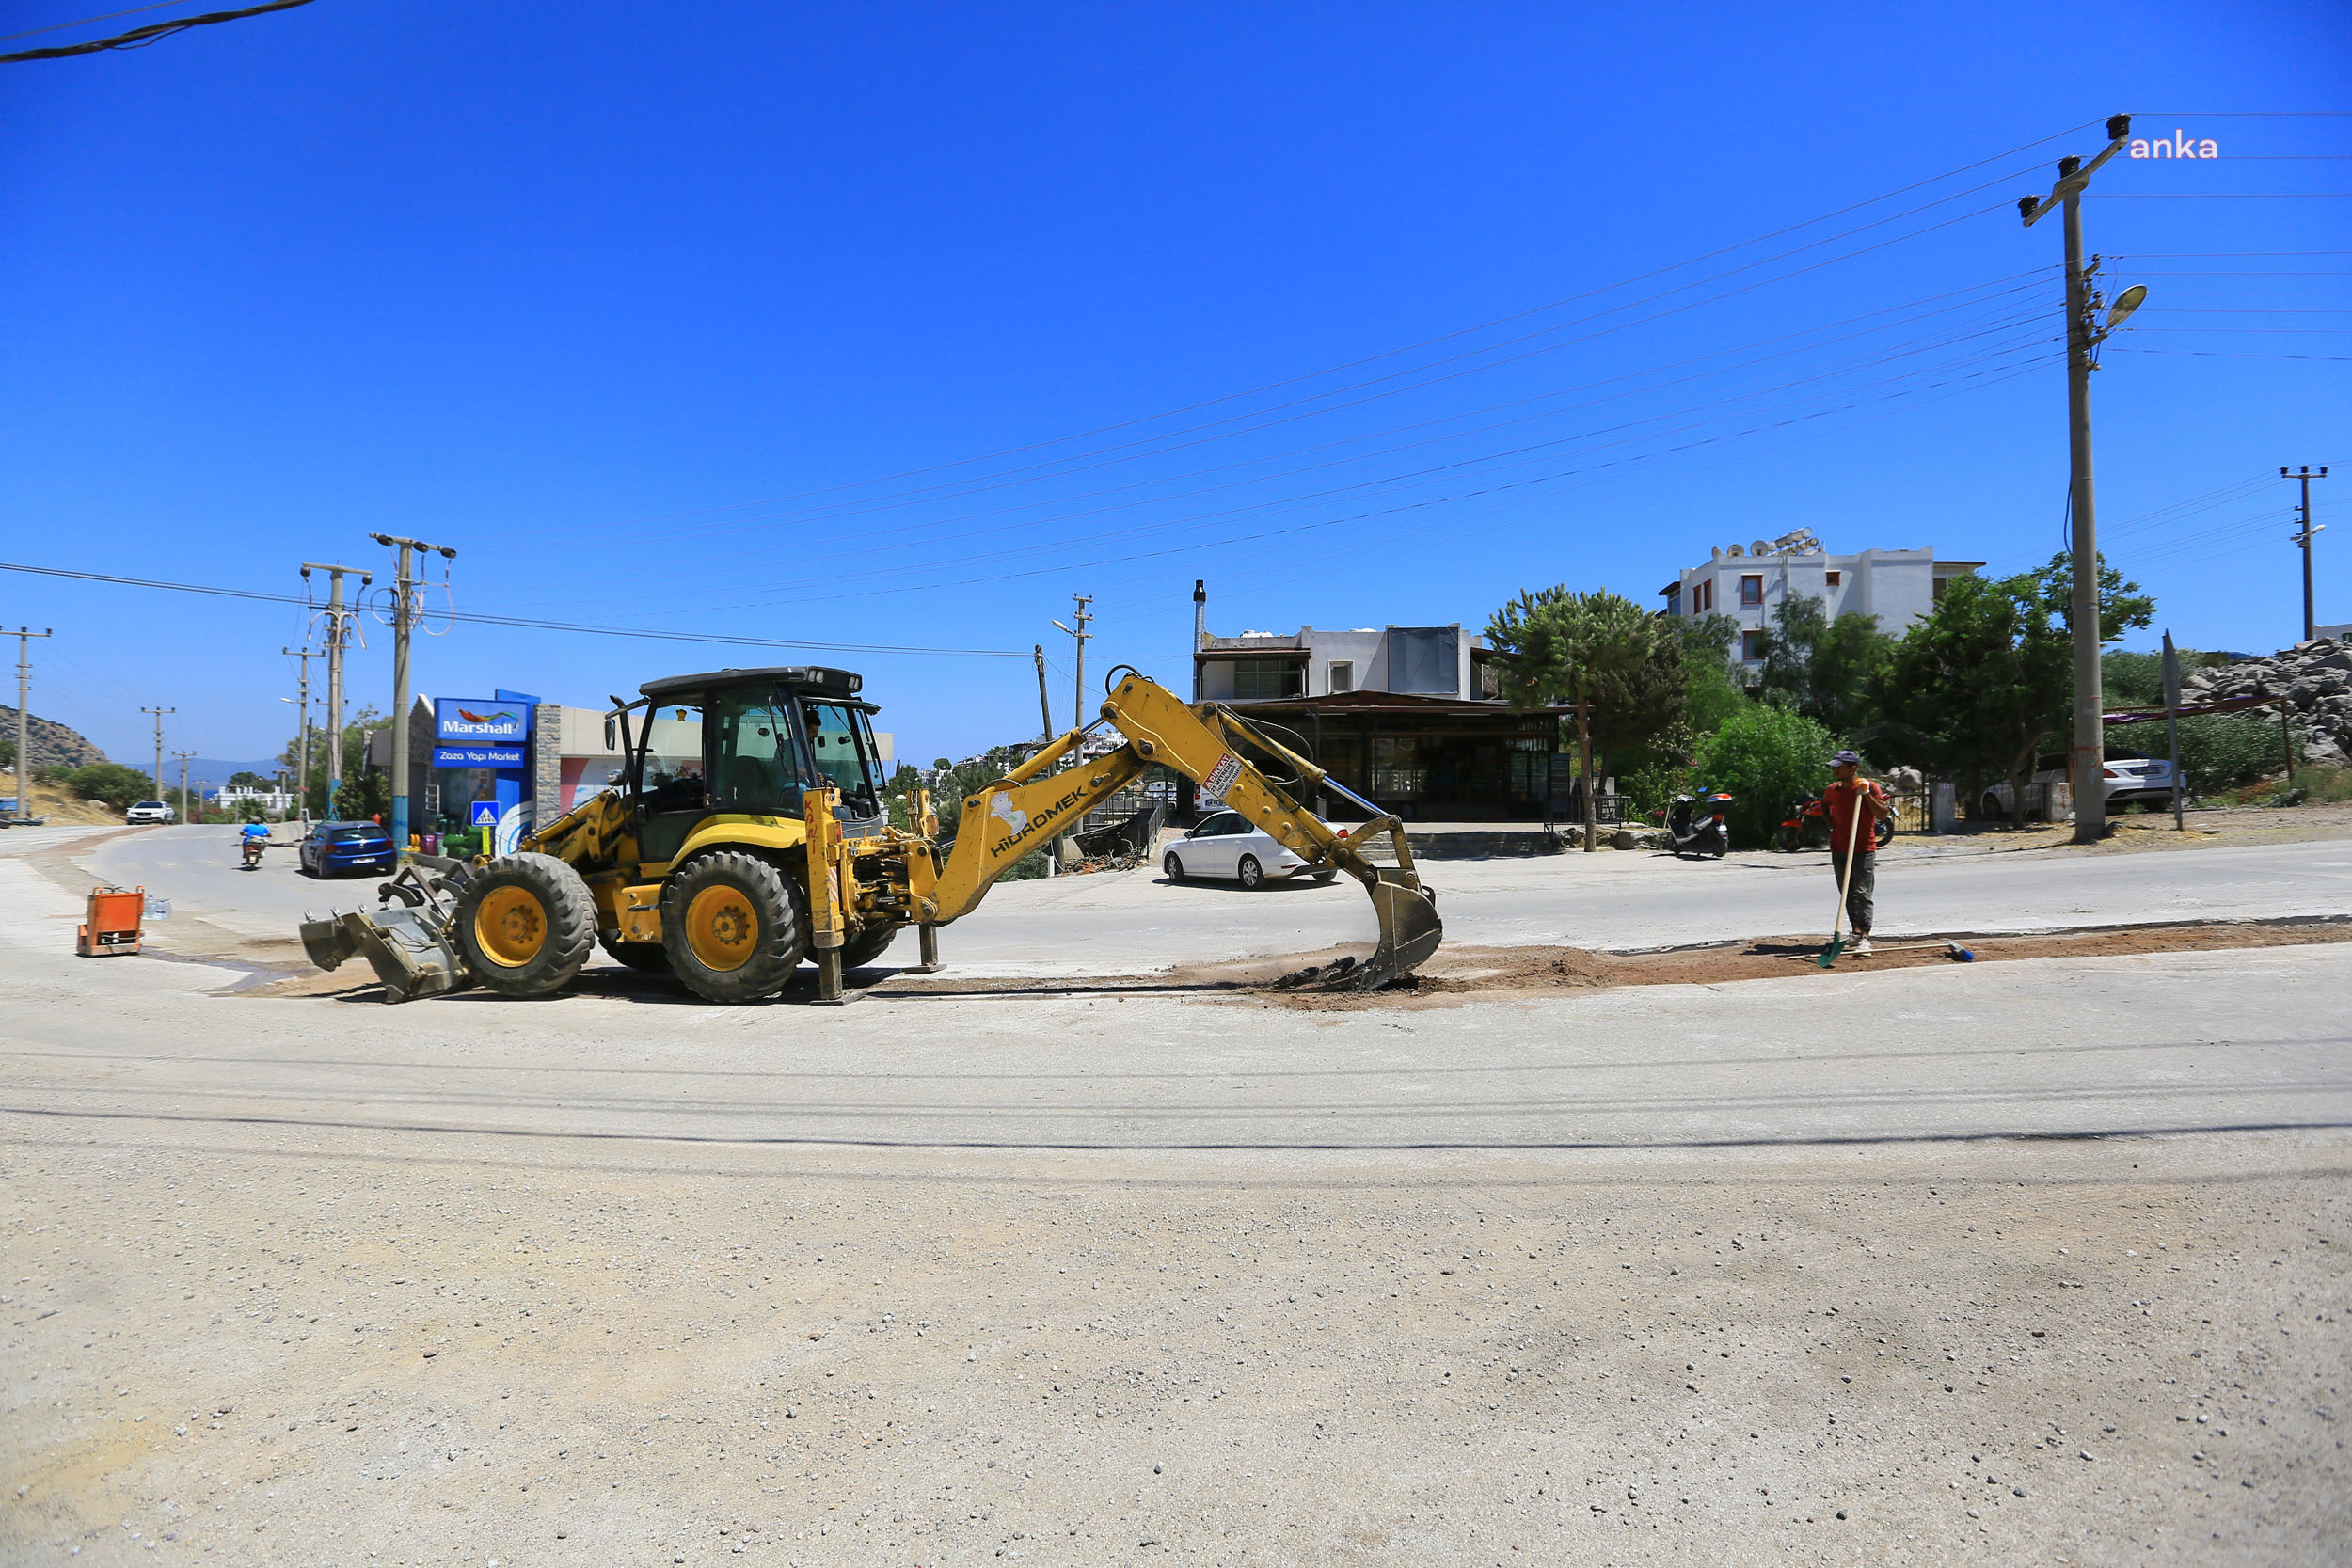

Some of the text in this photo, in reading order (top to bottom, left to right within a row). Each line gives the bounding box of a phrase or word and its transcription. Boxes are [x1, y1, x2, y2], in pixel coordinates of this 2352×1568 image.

[443, 721, 512, 734] Marshall
[439, 752, 519, 762] Zaza Yapı Market
[1215, 758, 1234, 786] METREDEN
